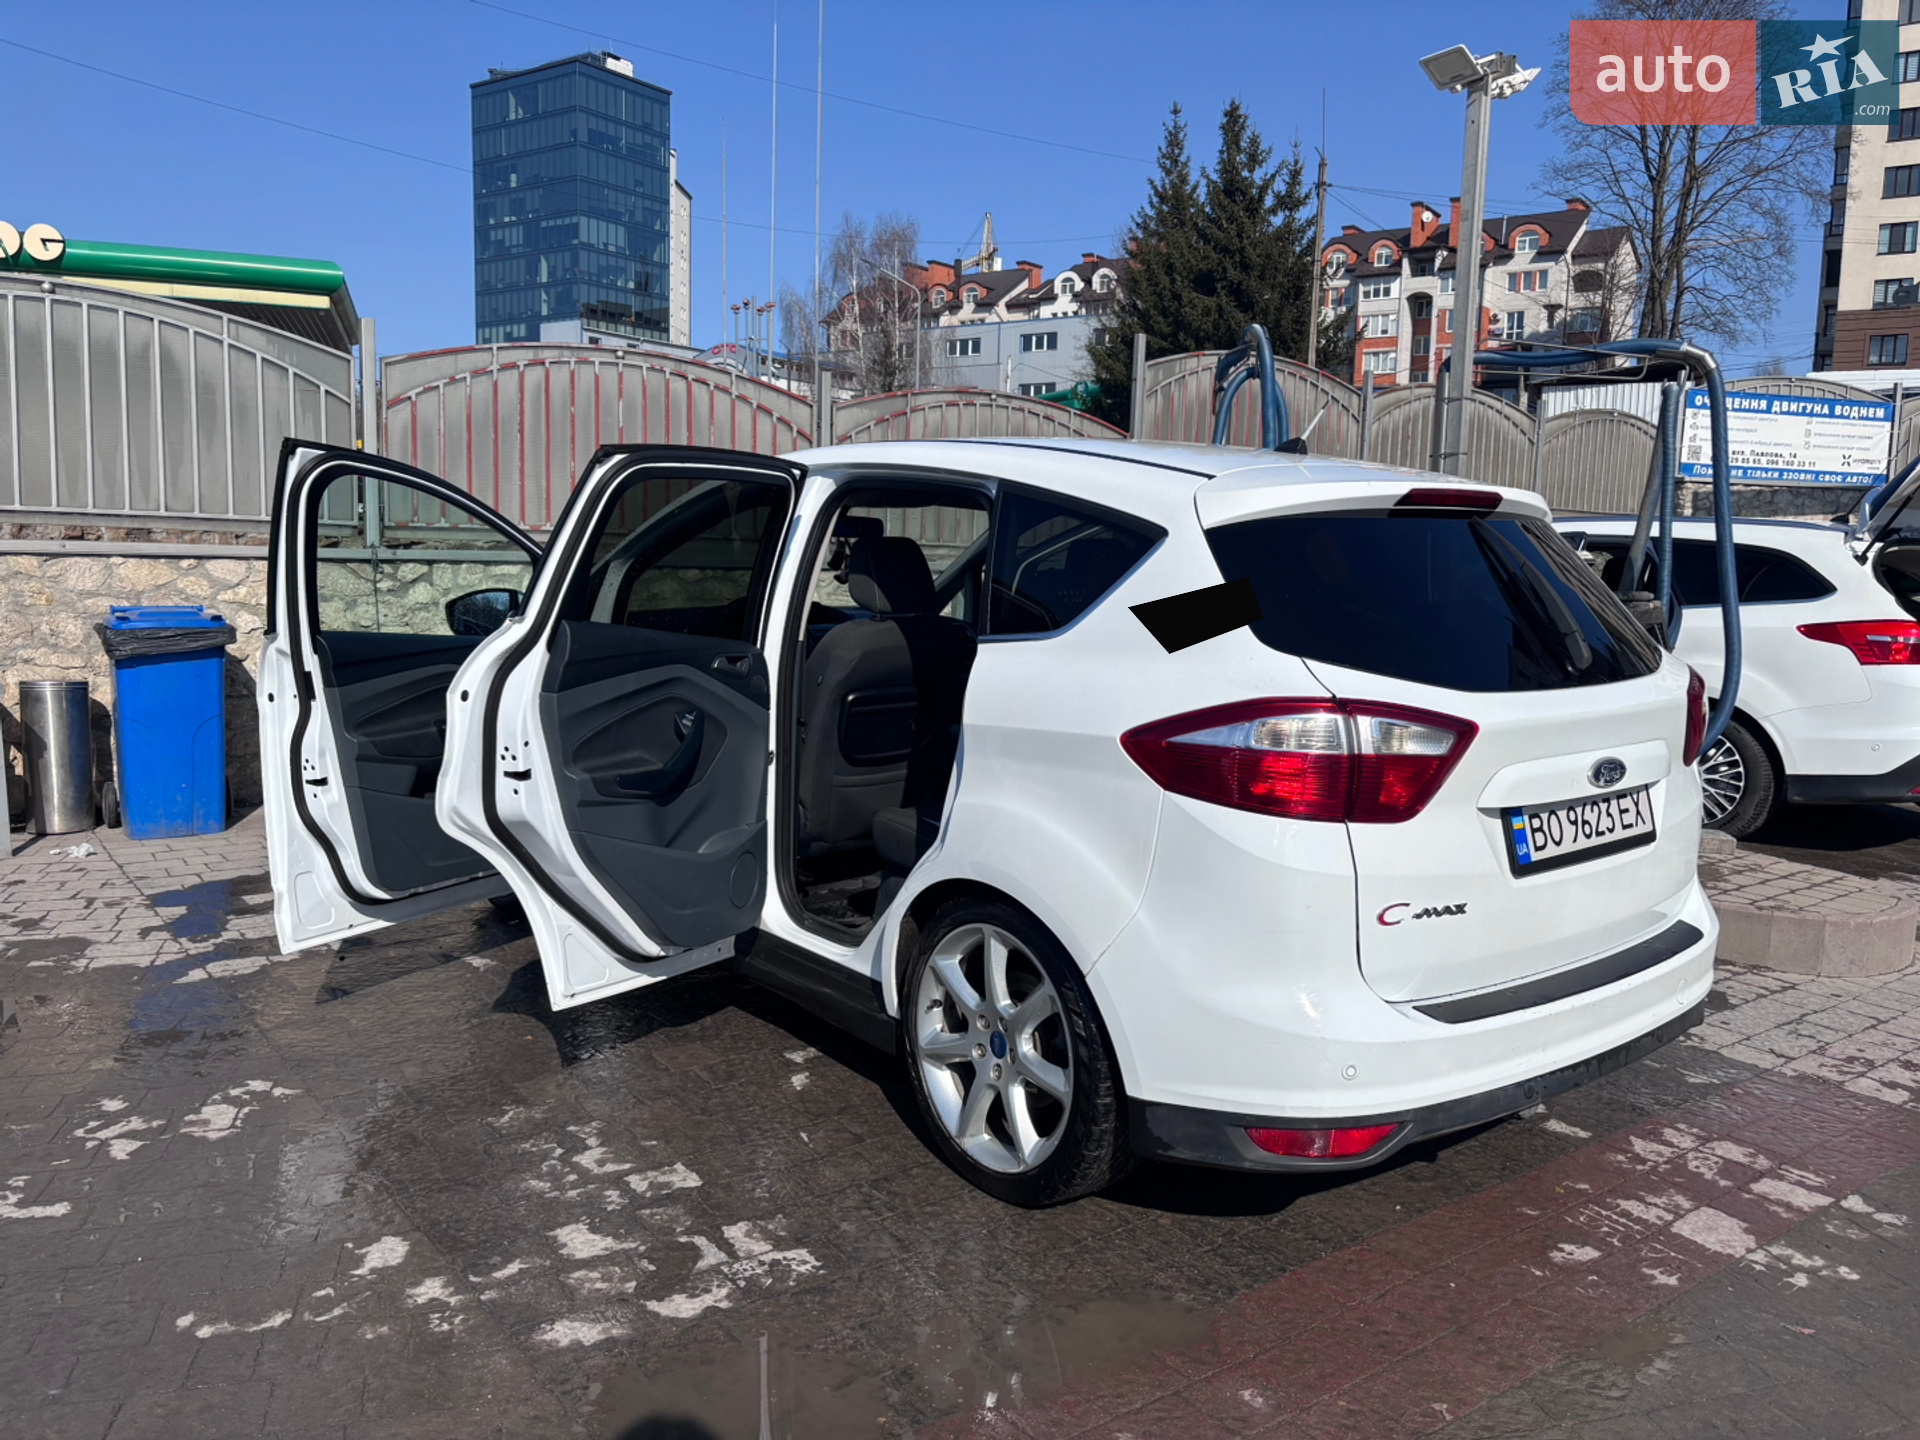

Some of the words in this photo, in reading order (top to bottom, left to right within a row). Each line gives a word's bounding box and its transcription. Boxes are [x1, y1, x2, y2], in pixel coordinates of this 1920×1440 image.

[1771, 400, 1829, 415] ДВИГУНА
[1834, 404, 1885, 419] ВОДНЕМ
[1516, 843, 1529, 856] UA
[1529, 809, 1564, 852] BO
[1566, 797, 1616, 844] 9623
[1616, 789, 1647, 831] EX
